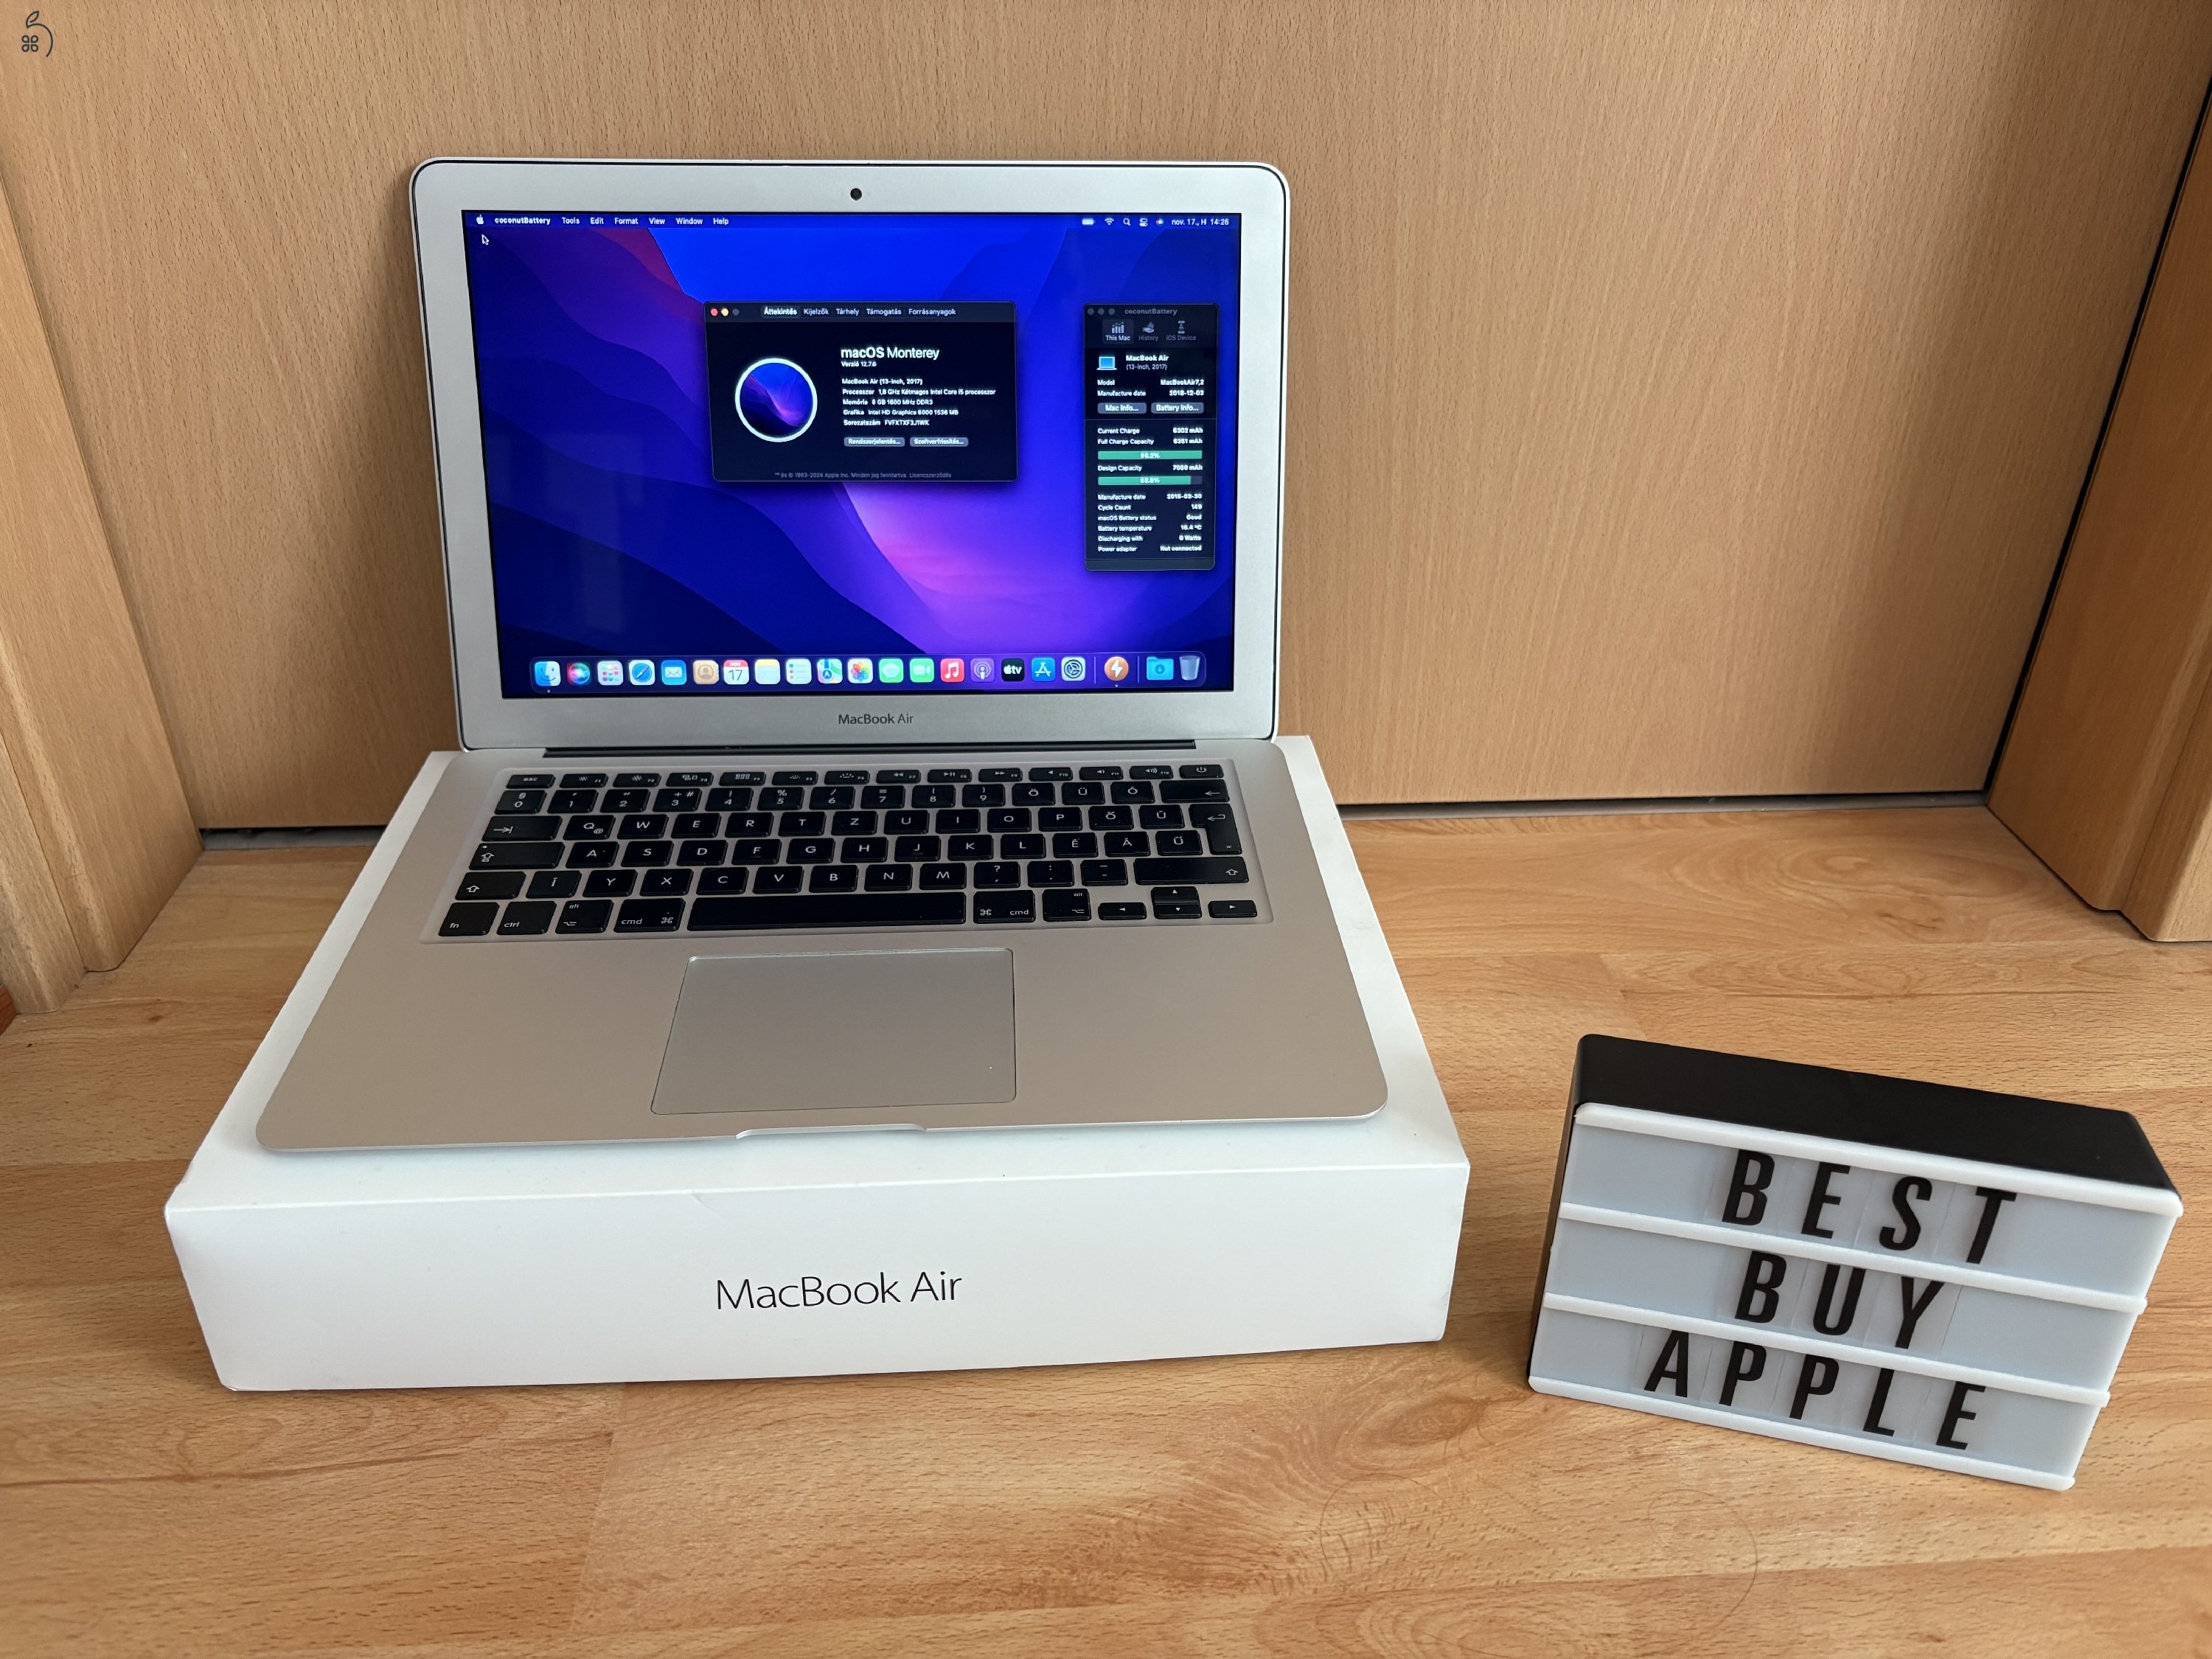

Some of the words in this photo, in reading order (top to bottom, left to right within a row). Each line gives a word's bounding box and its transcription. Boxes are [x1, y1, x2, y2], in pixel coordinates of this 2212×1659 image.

[494, 217, 551, 225] coconutBattery
[713, 218, 728, 226] Help
[763, 307, 797, 316] Áttekintés
[804, 308, 829, 316] Kijelzők
[835, 308, 859, 316] Tárhely
[866, 308, 902, 316] Támogatás
[908, 308, 956, 316] Forrásanyagok
[841, 347, 884, 358] macOS
[887, 347, 939, 361] Monterey
[1012, 665, 1022, 674] tv
[728, 669, 743, 681] 17
[838, 713, 895, 725] MacBook
[897, 713, 914, 724] Air
[1029, 788, 1039, 797] Ö
[1078, 787, 1088, 796] Ü
[1127, 786, 1138, 796] Ó
[1106, 811, 1116, 820] Ő
[1157, 810, 1166, 820] Ú
[583, 822, 594, 830] Q
[636, 821, 650, 829] W
[745, 819, 754, 827] R
[1020, 841, 1026, 849] L
[1071, 838, 1079, 848] É
[1122, 838, 1133, 847] Á
[1173, 836, 1183, 845] Ű
[805, 846, 816, 854] G
[914, 844, 920, 852] J
[966, 842, 975, 850] K
[586, 849, 597, 858] A
[643, 848, 652, 856] S
[717, 876, 728, 884] C
[774, 874, 785, 883] V
[830, 873, 838, 881] B
[883, 872, 894, 880] N
[936, 871, 950, 880] M
[551, 877, 558, 887] Í
[607, 877, 616, 886] Y
[661, 877, 672, 885] X
[1721, 1147, 2018, 1265] BEST
[717, 1271, 902, 1310] MacBook
[910, 1270, 962, 1302] Air
[1734, 1250, 1947, 1349] BUY
[1644, 1329, 1986, 1450] APPLE
